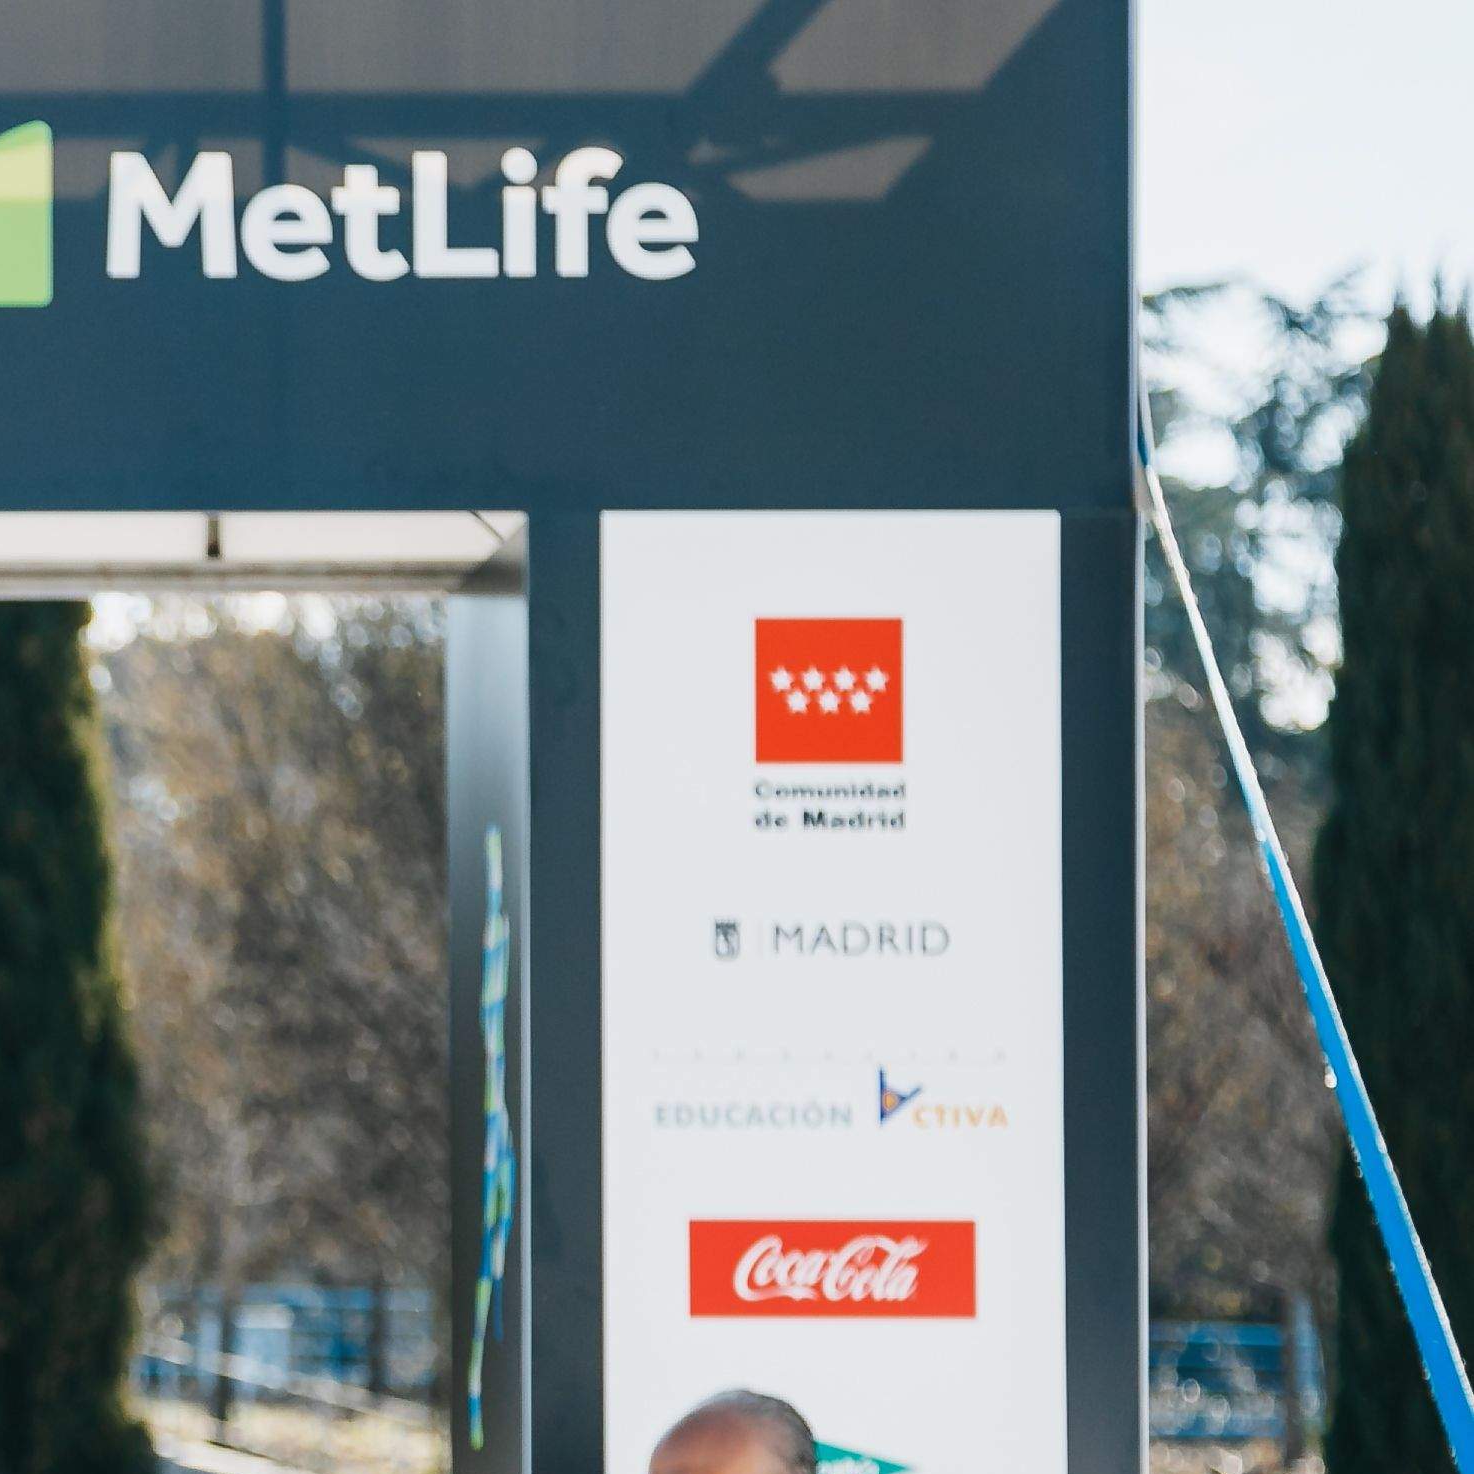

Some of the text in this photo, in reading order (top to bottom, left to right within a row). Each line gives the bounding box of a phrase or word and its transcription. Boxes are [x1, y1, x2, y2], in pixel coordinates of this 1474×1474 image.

[105, 146, 700, 282] MetLife
[754, 778, 907, 799] Comunidad
[754, 810, 907, 831] de Madrid
[772, 922, 953, 956] MADRID
[654, 1097, 854, 1129] EDUCACIÓN
[732, 1234, 930, 1302] Coca-Cola
